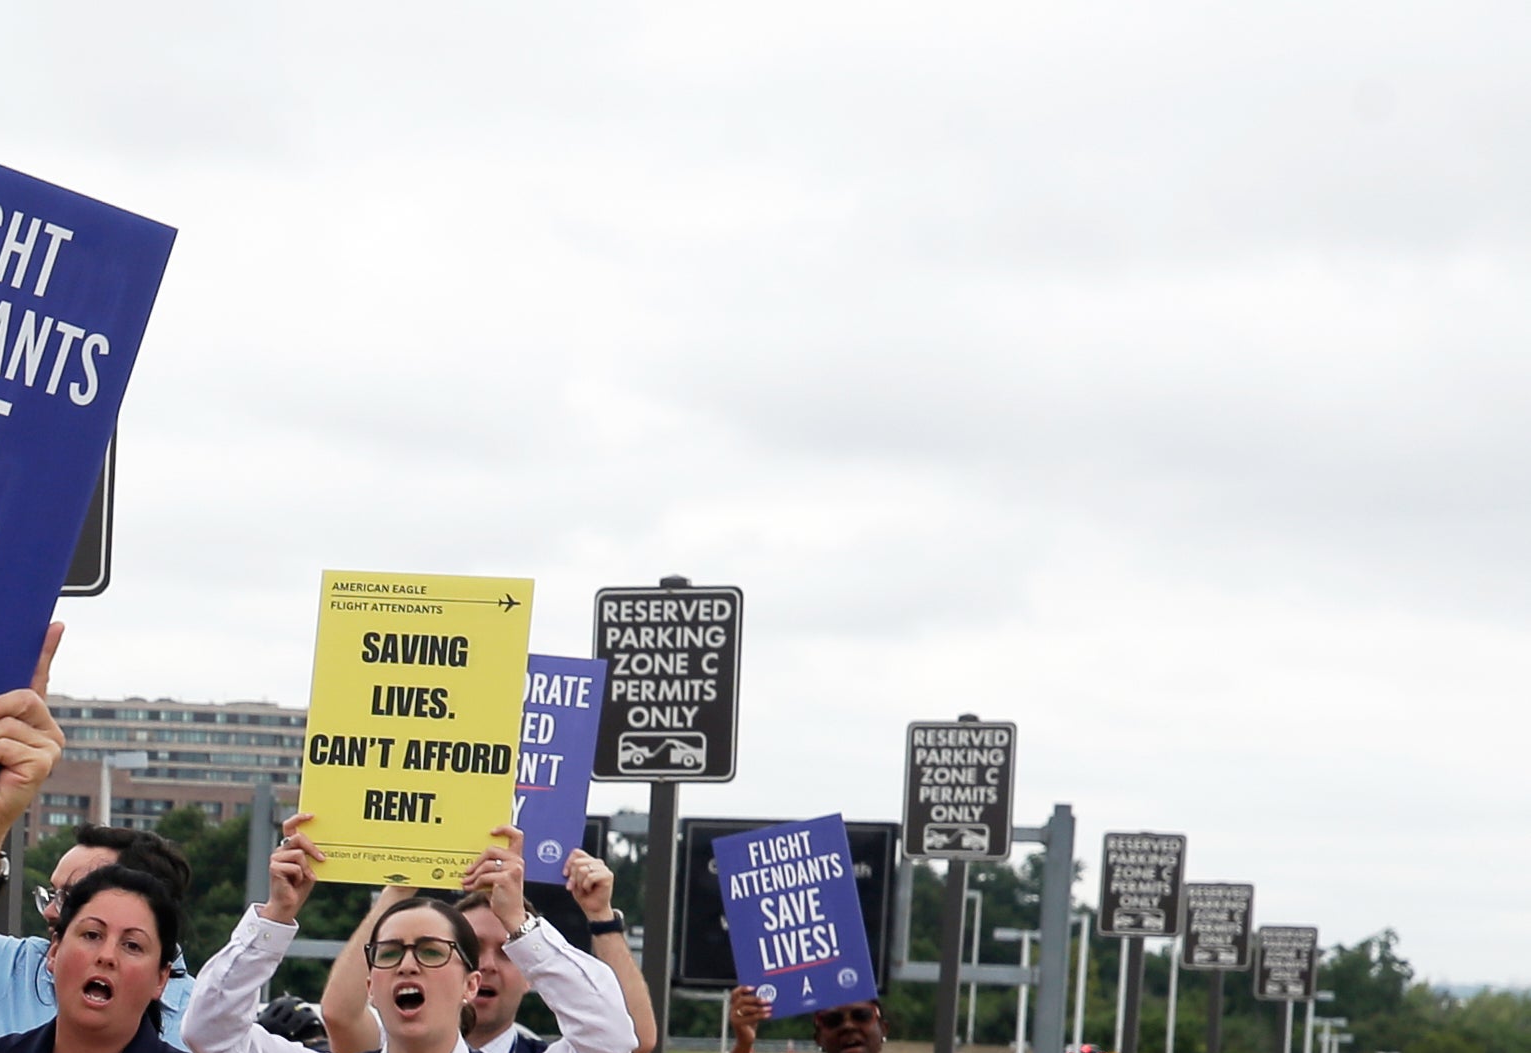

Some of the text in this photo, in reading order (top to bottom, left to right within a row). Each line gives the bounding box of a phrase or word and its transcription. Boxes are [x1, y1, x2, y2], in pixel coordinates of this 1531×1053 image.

[332, 581, 427, 595] AMERICAN EAGLE
[331, 602, 443, 615] FLIGHT ATTENDANTS
[603, 600, 732, 623] RESERVED
[606, 626, 726, 649] PARKING
[361, 631, 469, 668] SAVING
[613, 653, 719, 676] ZONE C
[611, 679, 718, 702] PERMITS
[371, 686, 455, 720] LIVES.
[627, 706, 699, 729] ONLY
[913, 729, 1009, 747] RESERVED
[309, 734, 512, 775] CAN'T AFFORD
[915, 748, 1005, 766] PARKING
[921, 767, 1000, 785] ZONE C
[364, 789, 443, 824] RENT.
[919, 786, 998, 804] PERMITS
[930, 805, 984, 822] ONLY
[352, 852, 361, 860] of
[363, 852, 386, 862] Flight
[748, 831, 810, 868] FLIGHT
[730, 853, 844, 901] ATTENDANTS
[1113, 867, 1156, 879] ZONE
[760, 888, 825, 931] SAVE
[758, 923, 840, 971] LIVES!
